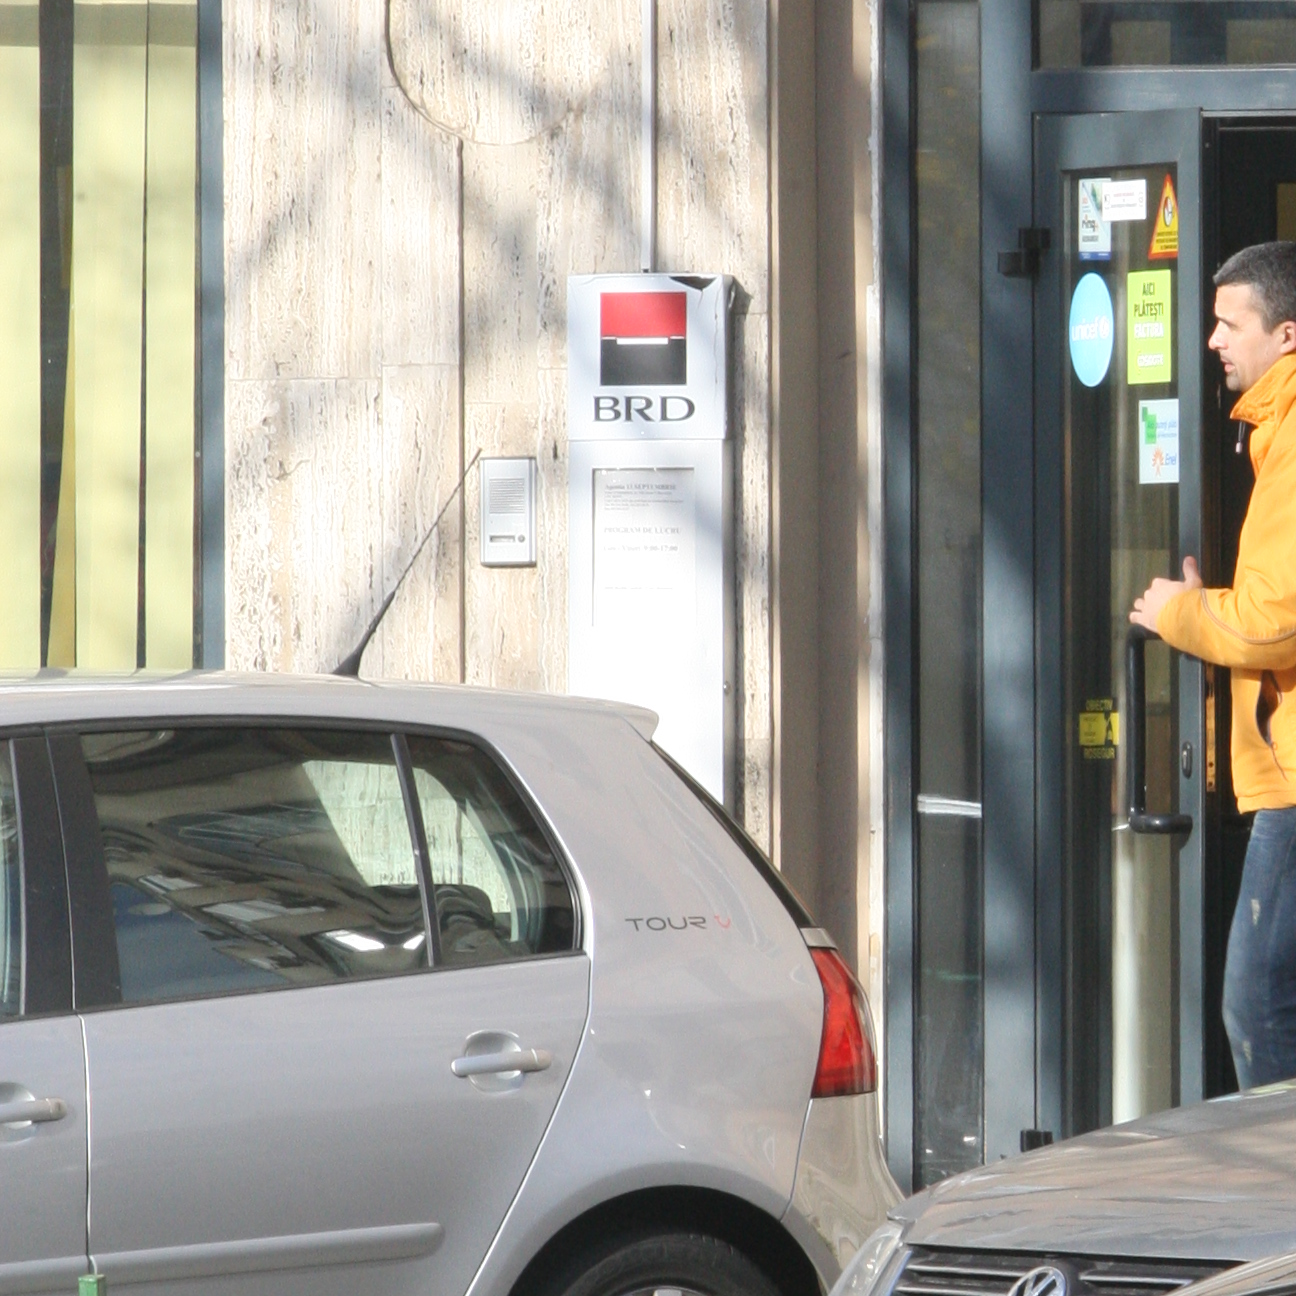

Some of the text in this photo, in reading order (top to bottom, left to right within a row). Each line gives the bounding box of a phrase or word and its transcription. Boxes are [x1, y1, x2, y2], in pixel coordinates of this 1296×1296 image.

[1142, 282, 1155, 296] AICI
[1072, 315, 1098, 341] unicef
[593, 395, 696, 422] BRD
[625, 916, 706, 931] TOUR
